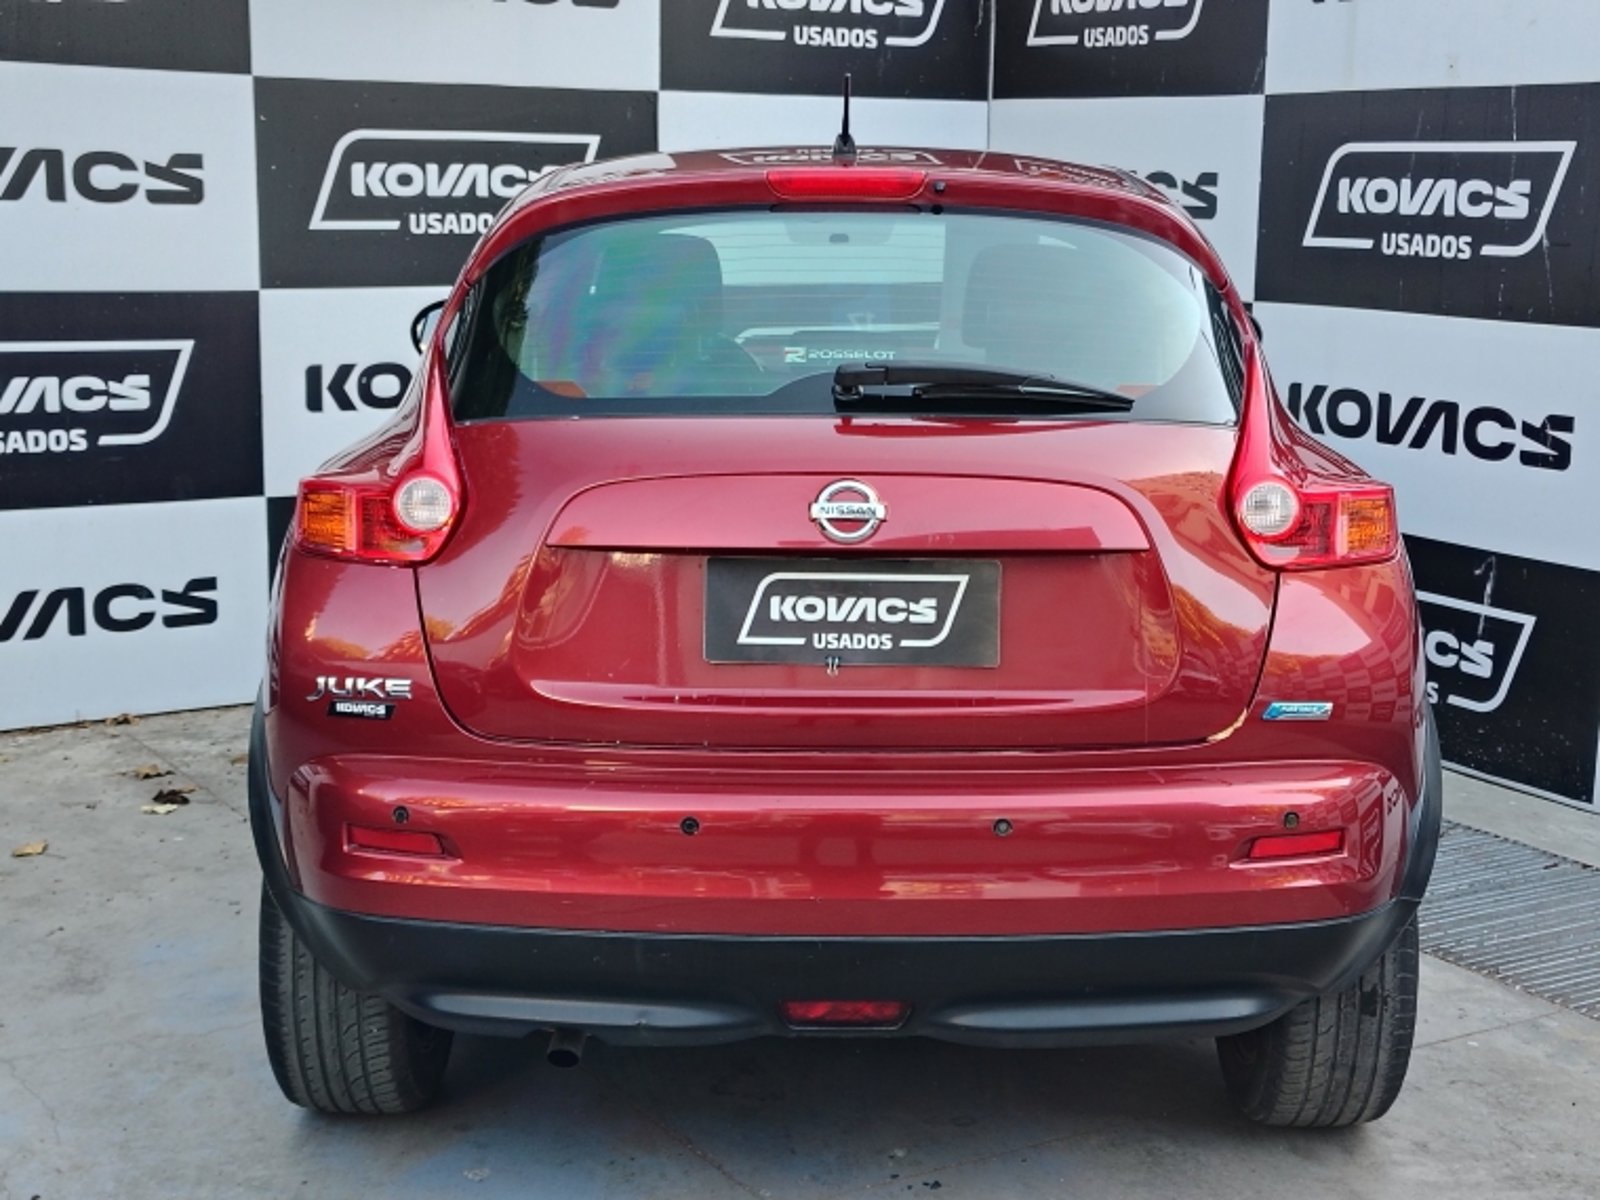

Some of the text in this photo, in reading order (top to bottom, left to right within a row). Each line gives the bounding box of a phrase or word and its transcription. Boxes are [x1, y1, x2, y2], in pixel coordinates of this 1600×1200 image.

[793, 25, 878, 48] USADOS
[1083, 25, 1149, 47] USADOS
[0, 147, 204, 205] ACS
[1337, 177, 1531, 219] KOVACS
[1380, 232, 1472, 260] USADOS
[1288, 382, 1575, 471] KOVACS
[0, 429, 88, 455] ADOS
[819, 505, 877, 517] NISSAN
[770, 596, 937, 624] KOVACS
[813, 633, 893, 650] USADOS
[306, 676, 412, 701] JUKE
